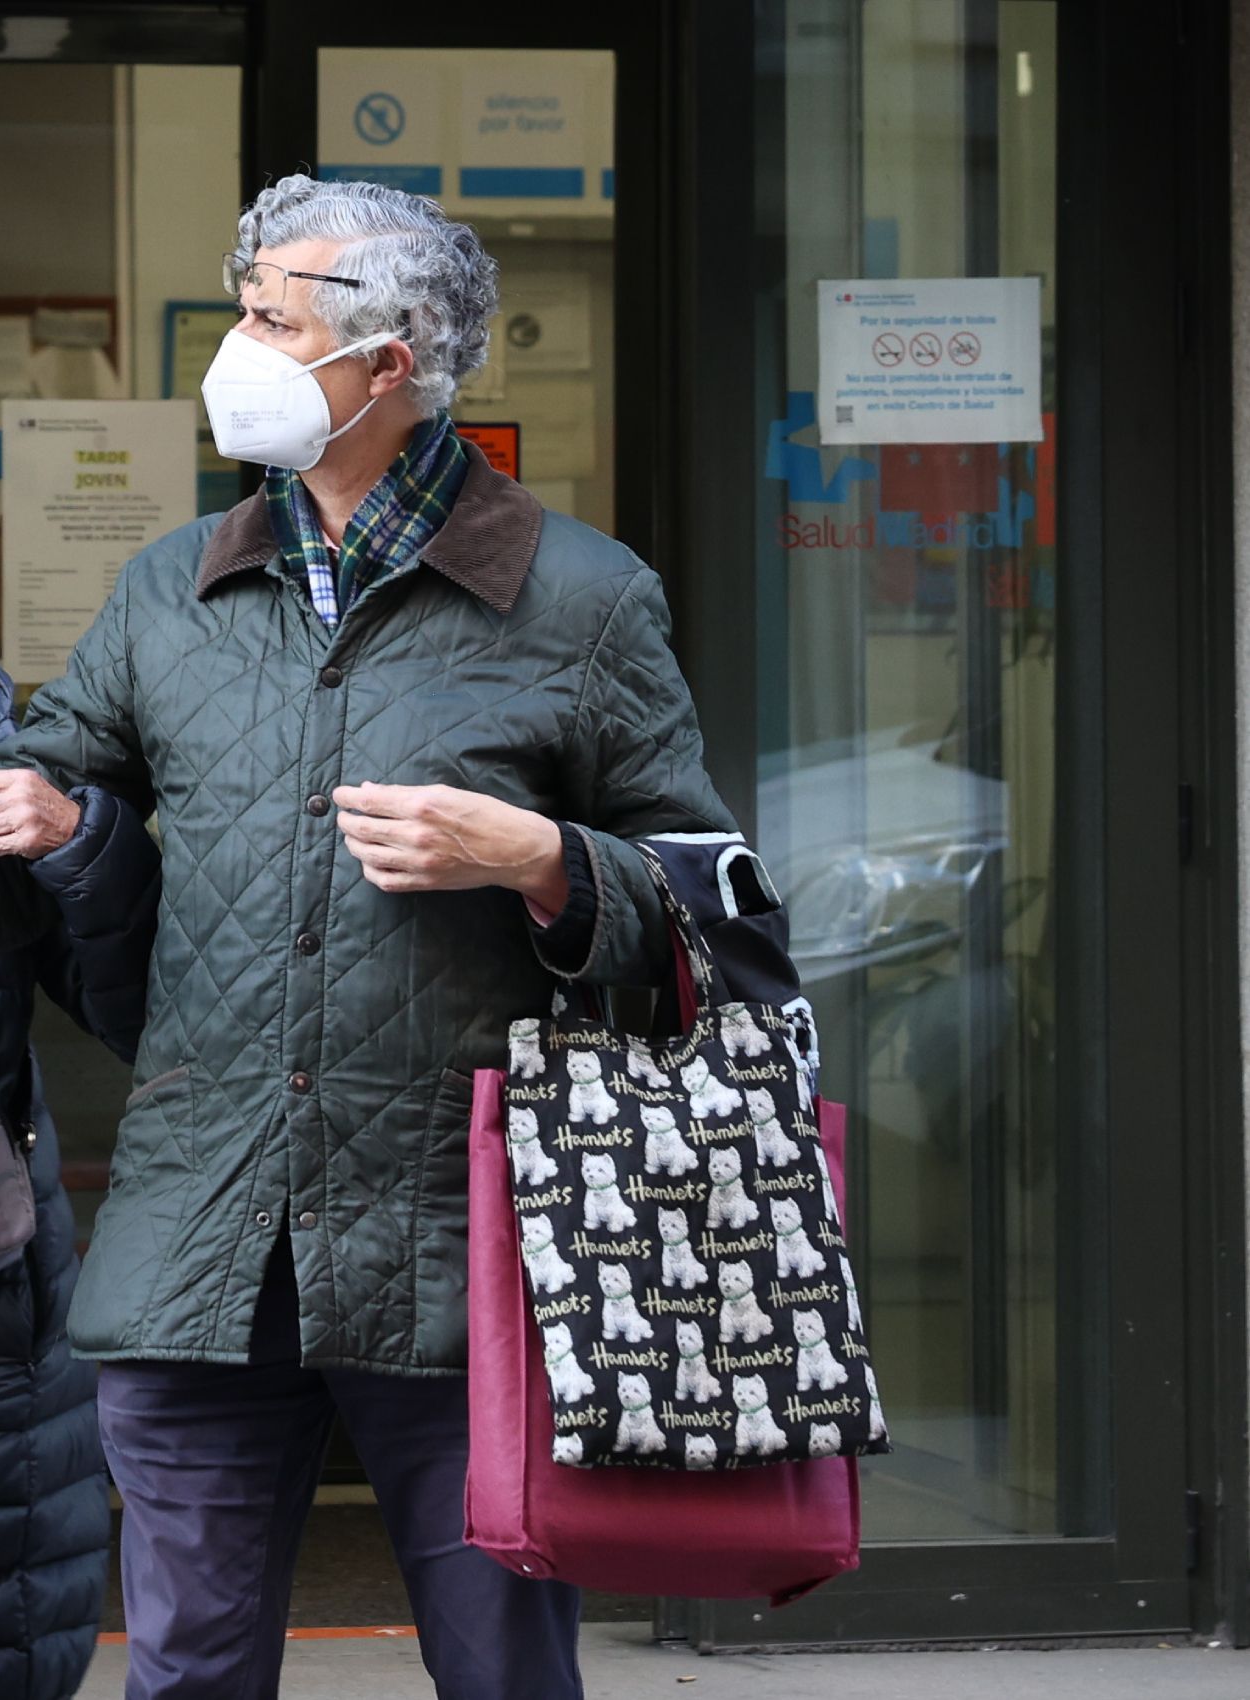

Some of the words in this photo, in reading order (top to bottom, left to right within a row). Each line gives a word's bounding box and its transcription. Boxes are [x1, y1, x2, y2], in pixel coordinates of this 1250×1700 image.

[860, 316, 879, 326] Por
[894, 316, 947, 328] seguridad
[966, 315, 997, 325] todos
[76, 450, 129, 465] TARDE
[75, 473, 128, 489] JOVEN
[685, 1115, 756, 1146] Hamlet
